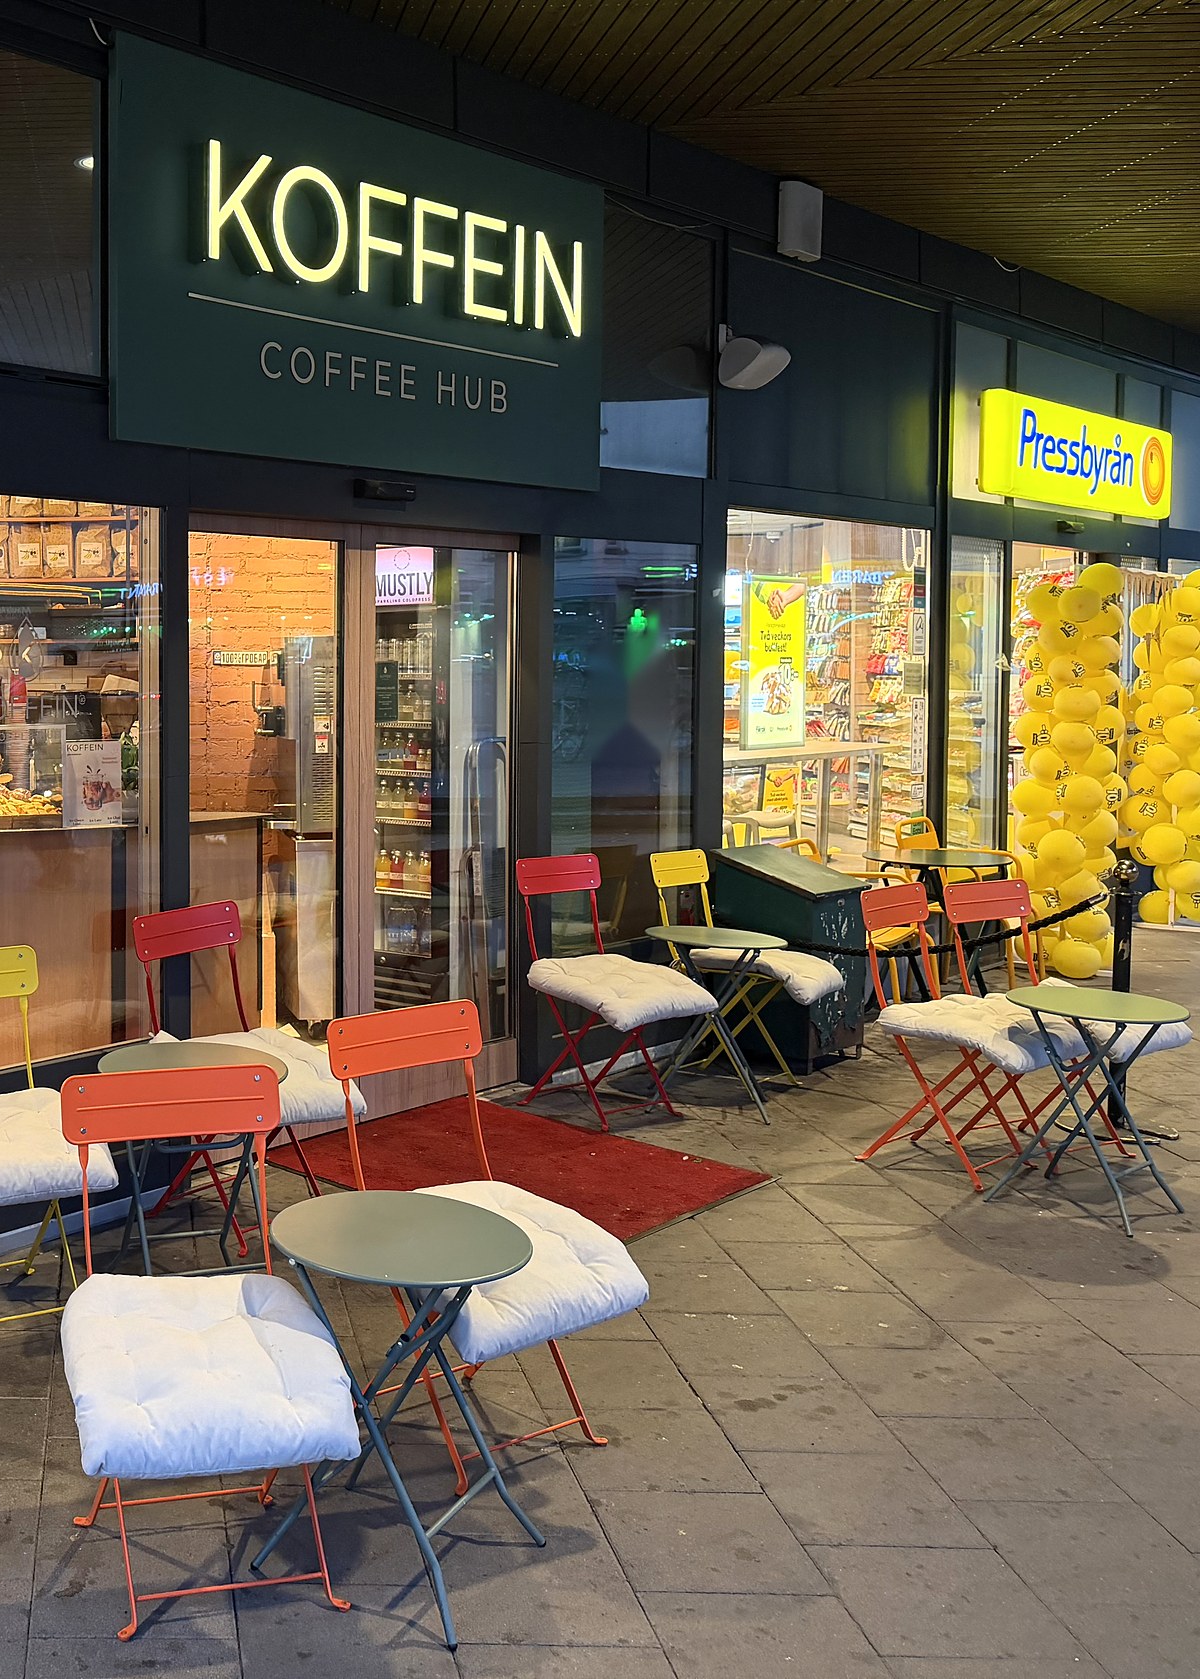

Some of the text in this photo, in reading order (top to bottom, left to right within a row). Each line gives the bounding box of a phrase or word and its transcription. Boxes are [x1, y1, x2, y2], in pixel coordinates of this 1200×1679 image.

[207, 138, 583, 338] KOFFEIN
[259, 340, 509, 415] COFFEE HUB
[1017, 407, 1135, 496] Pressbyrån
[376, 572, 433, 597] MUSTLY
[66, 743, 104, 752] KOFFEIN
